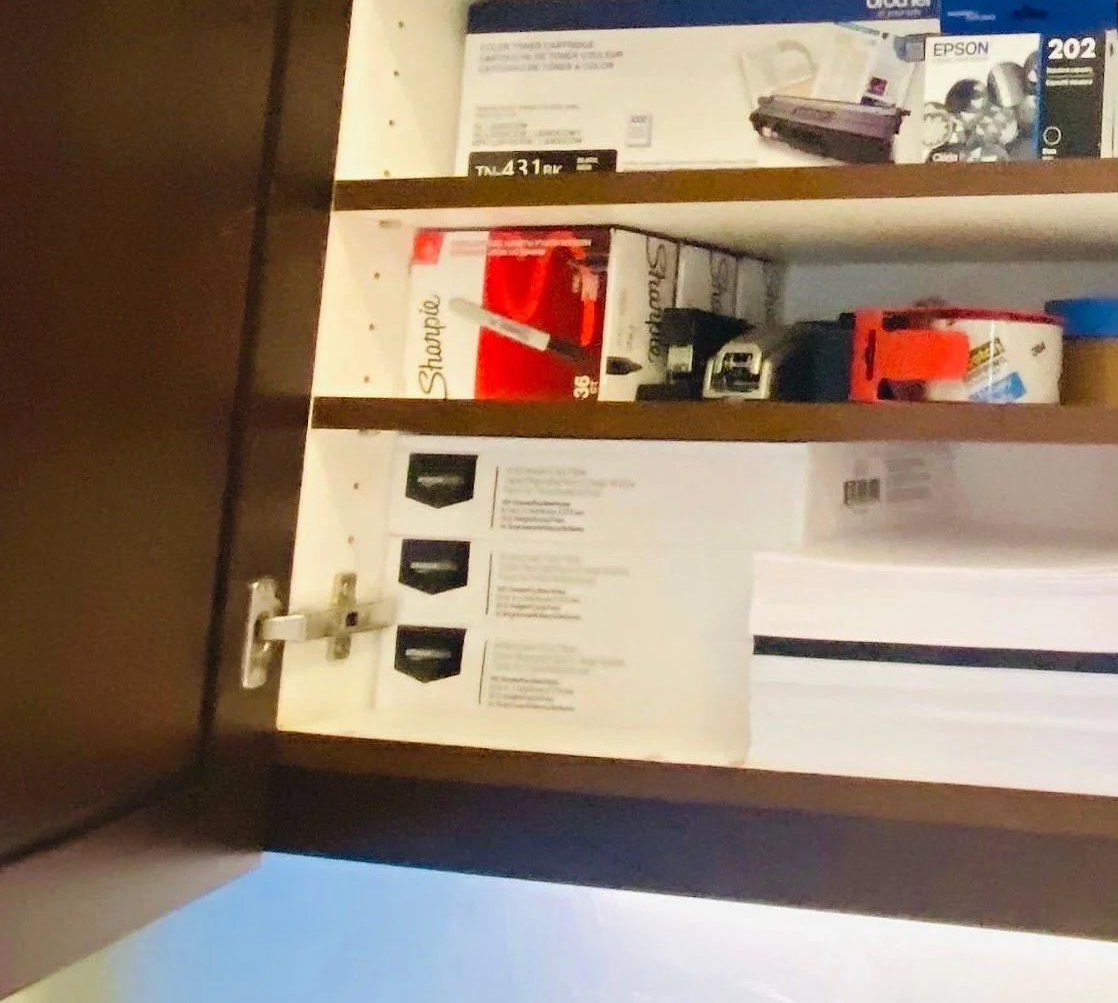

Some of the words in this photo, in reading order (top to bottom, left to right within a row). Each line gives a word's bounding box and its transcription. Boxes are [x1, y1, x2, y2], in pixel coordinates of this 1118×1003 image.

[933, 41, 989, 58] EPSON
[1048, 37, 1097, 60] 202
[418, 295, 447, 399] Sharpie
[573, 375, 591, 399] 36
